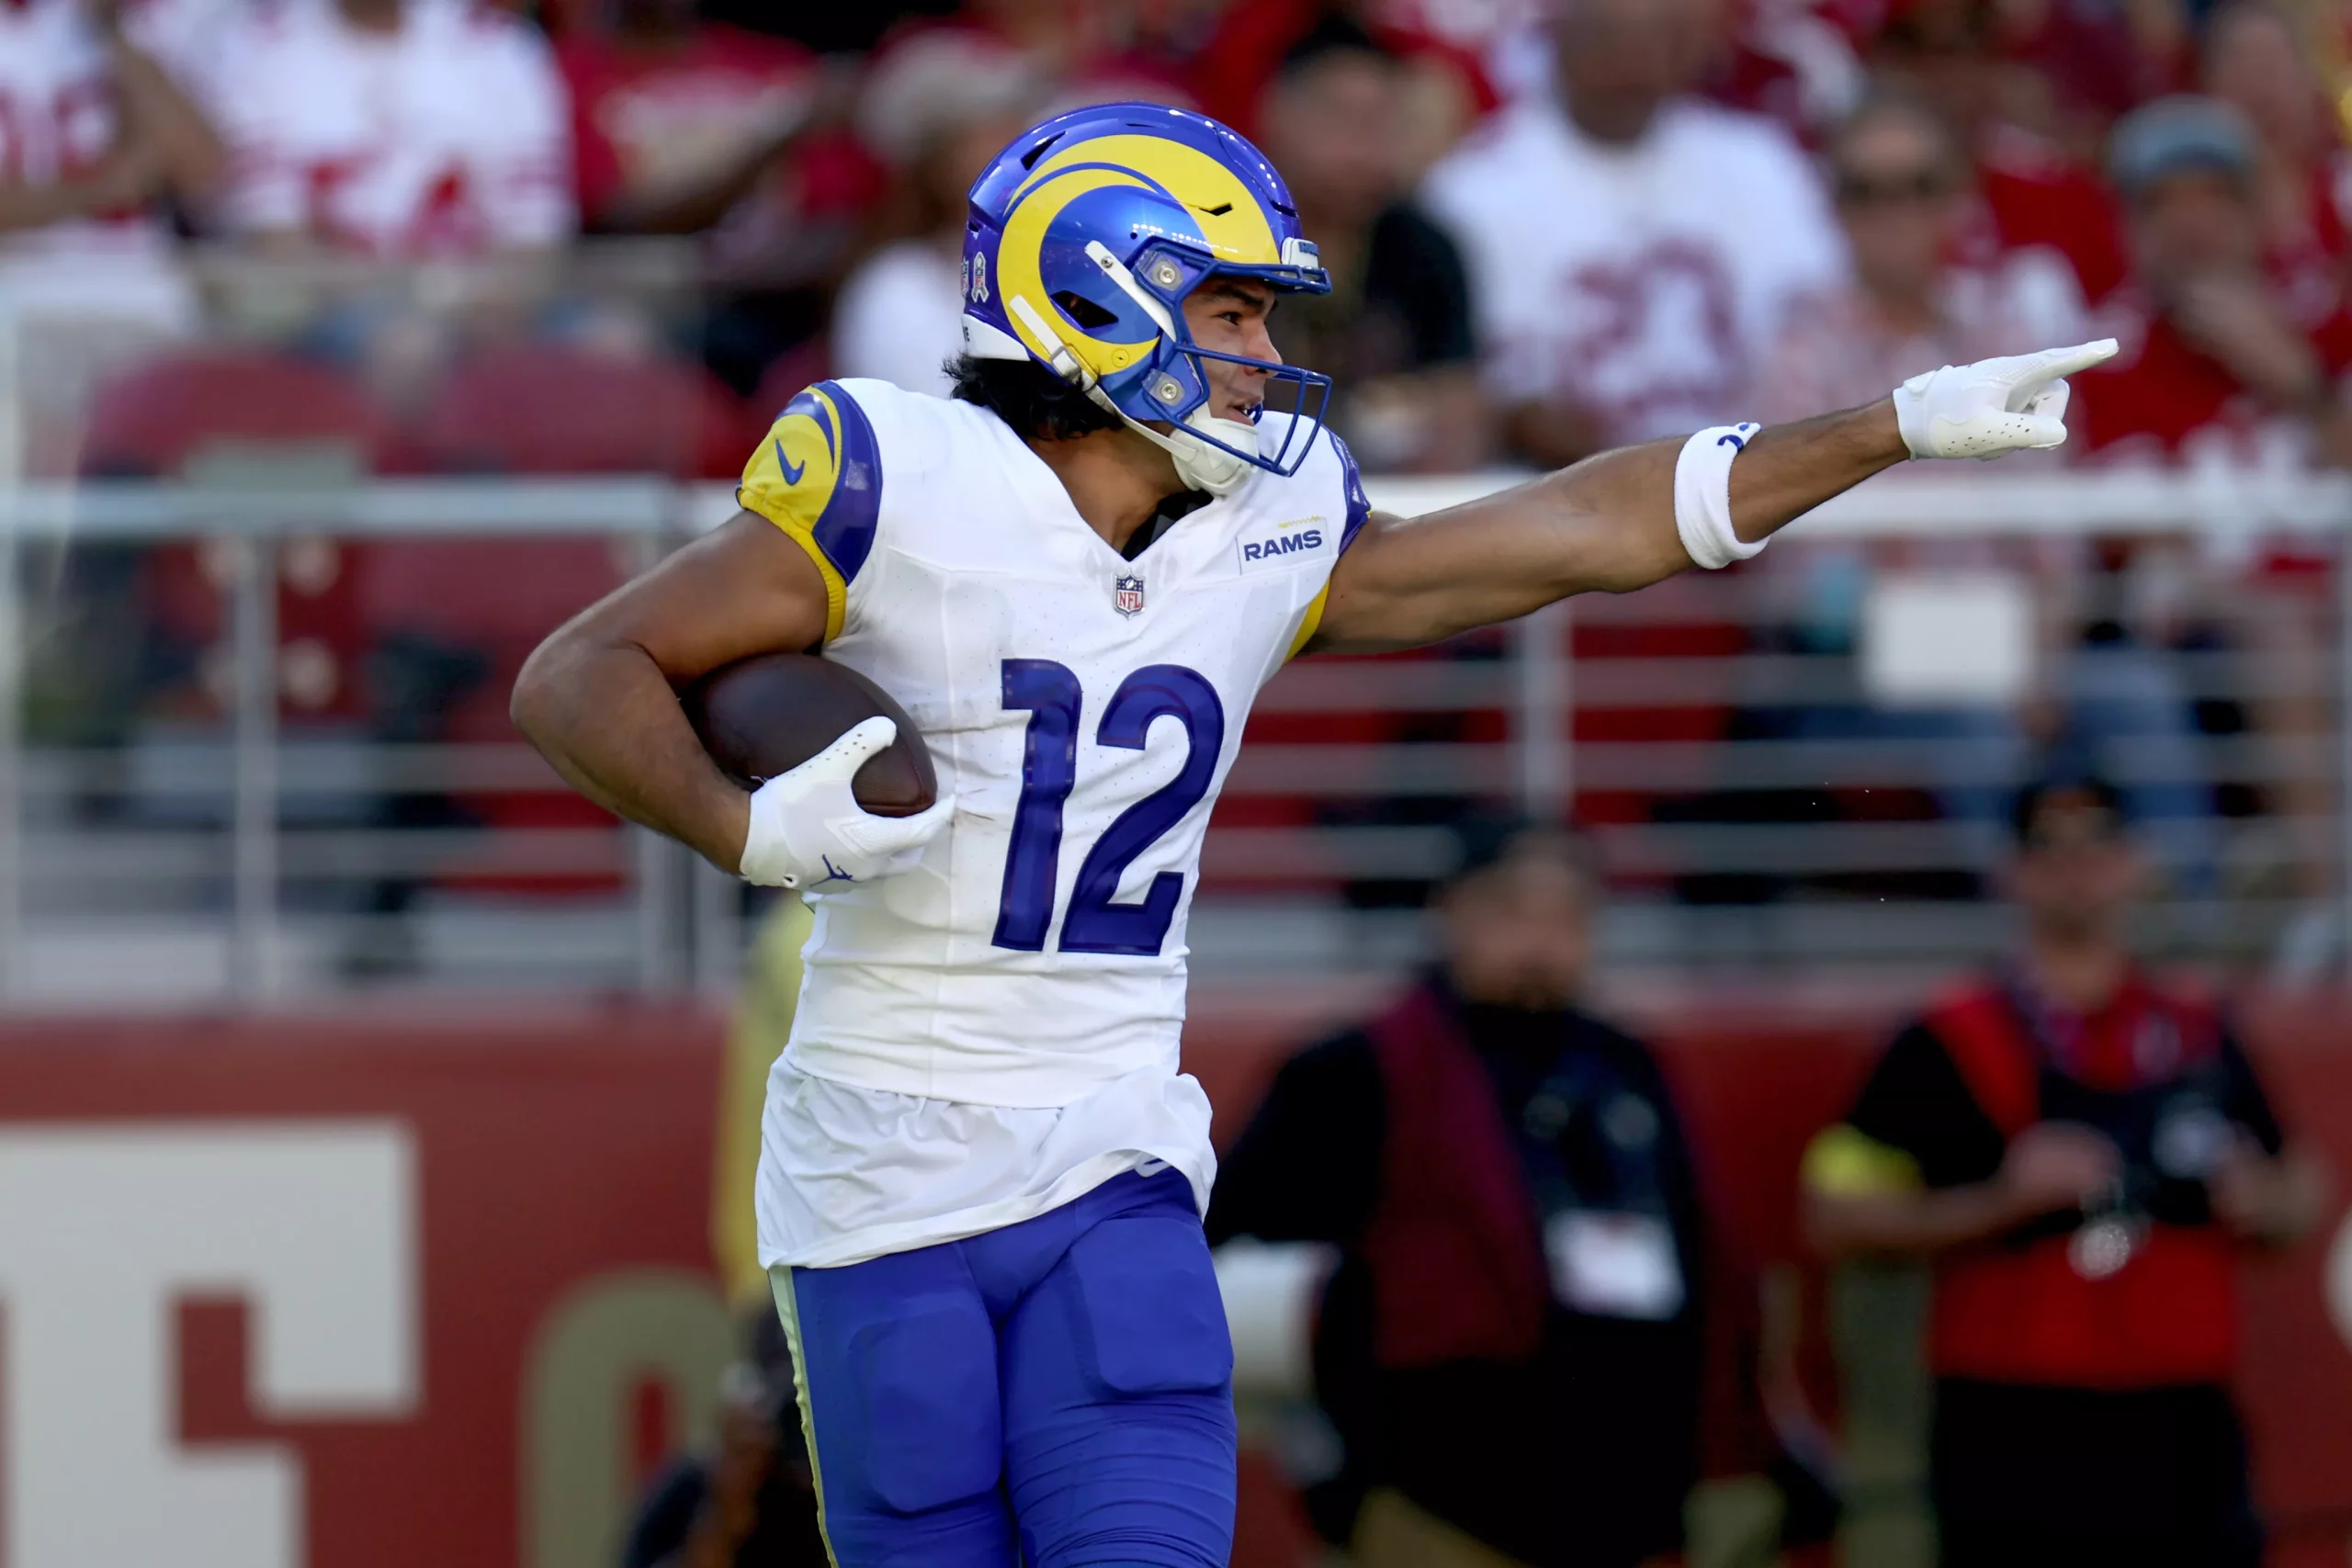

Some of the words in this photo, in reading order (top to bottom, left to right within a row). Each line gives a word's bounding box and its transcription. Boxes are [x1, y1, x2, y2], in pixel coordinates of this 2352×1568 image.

[1243, 529, 1323, 561] RAMS
[1118, 591, 1141, 610] NFL
[991, 659, 1225, 956] 12
